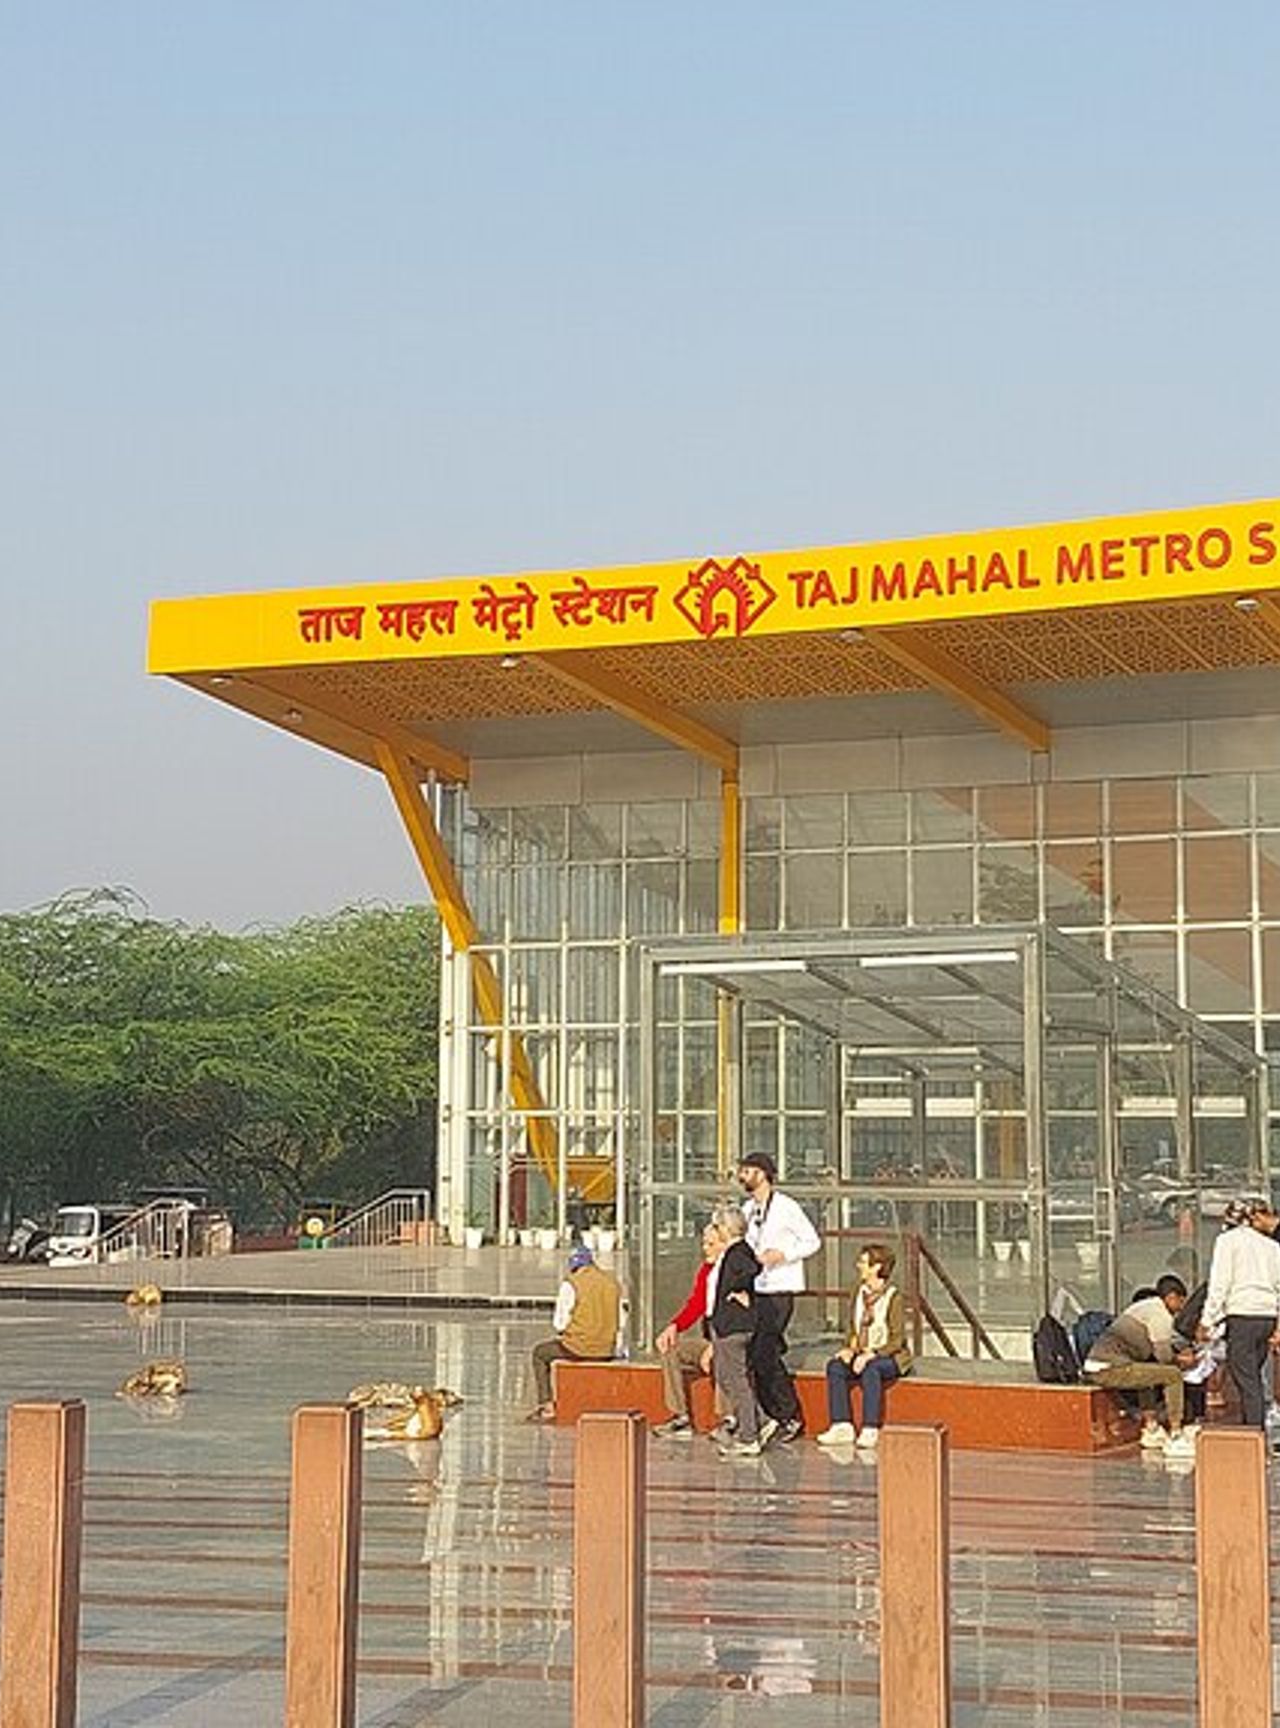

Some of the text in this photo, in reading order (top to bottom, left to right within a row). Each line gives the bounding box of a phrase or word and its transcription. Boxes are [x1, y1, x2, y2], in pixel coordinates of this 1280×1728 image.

[787, 566, 860, 608] TAJ
[870, 549, 1039, 602] MAHAL
[1056, 527, 1232, 585] METRO
[299, 576, 659, 642] ताज महल मेट्रो स्टेशन
